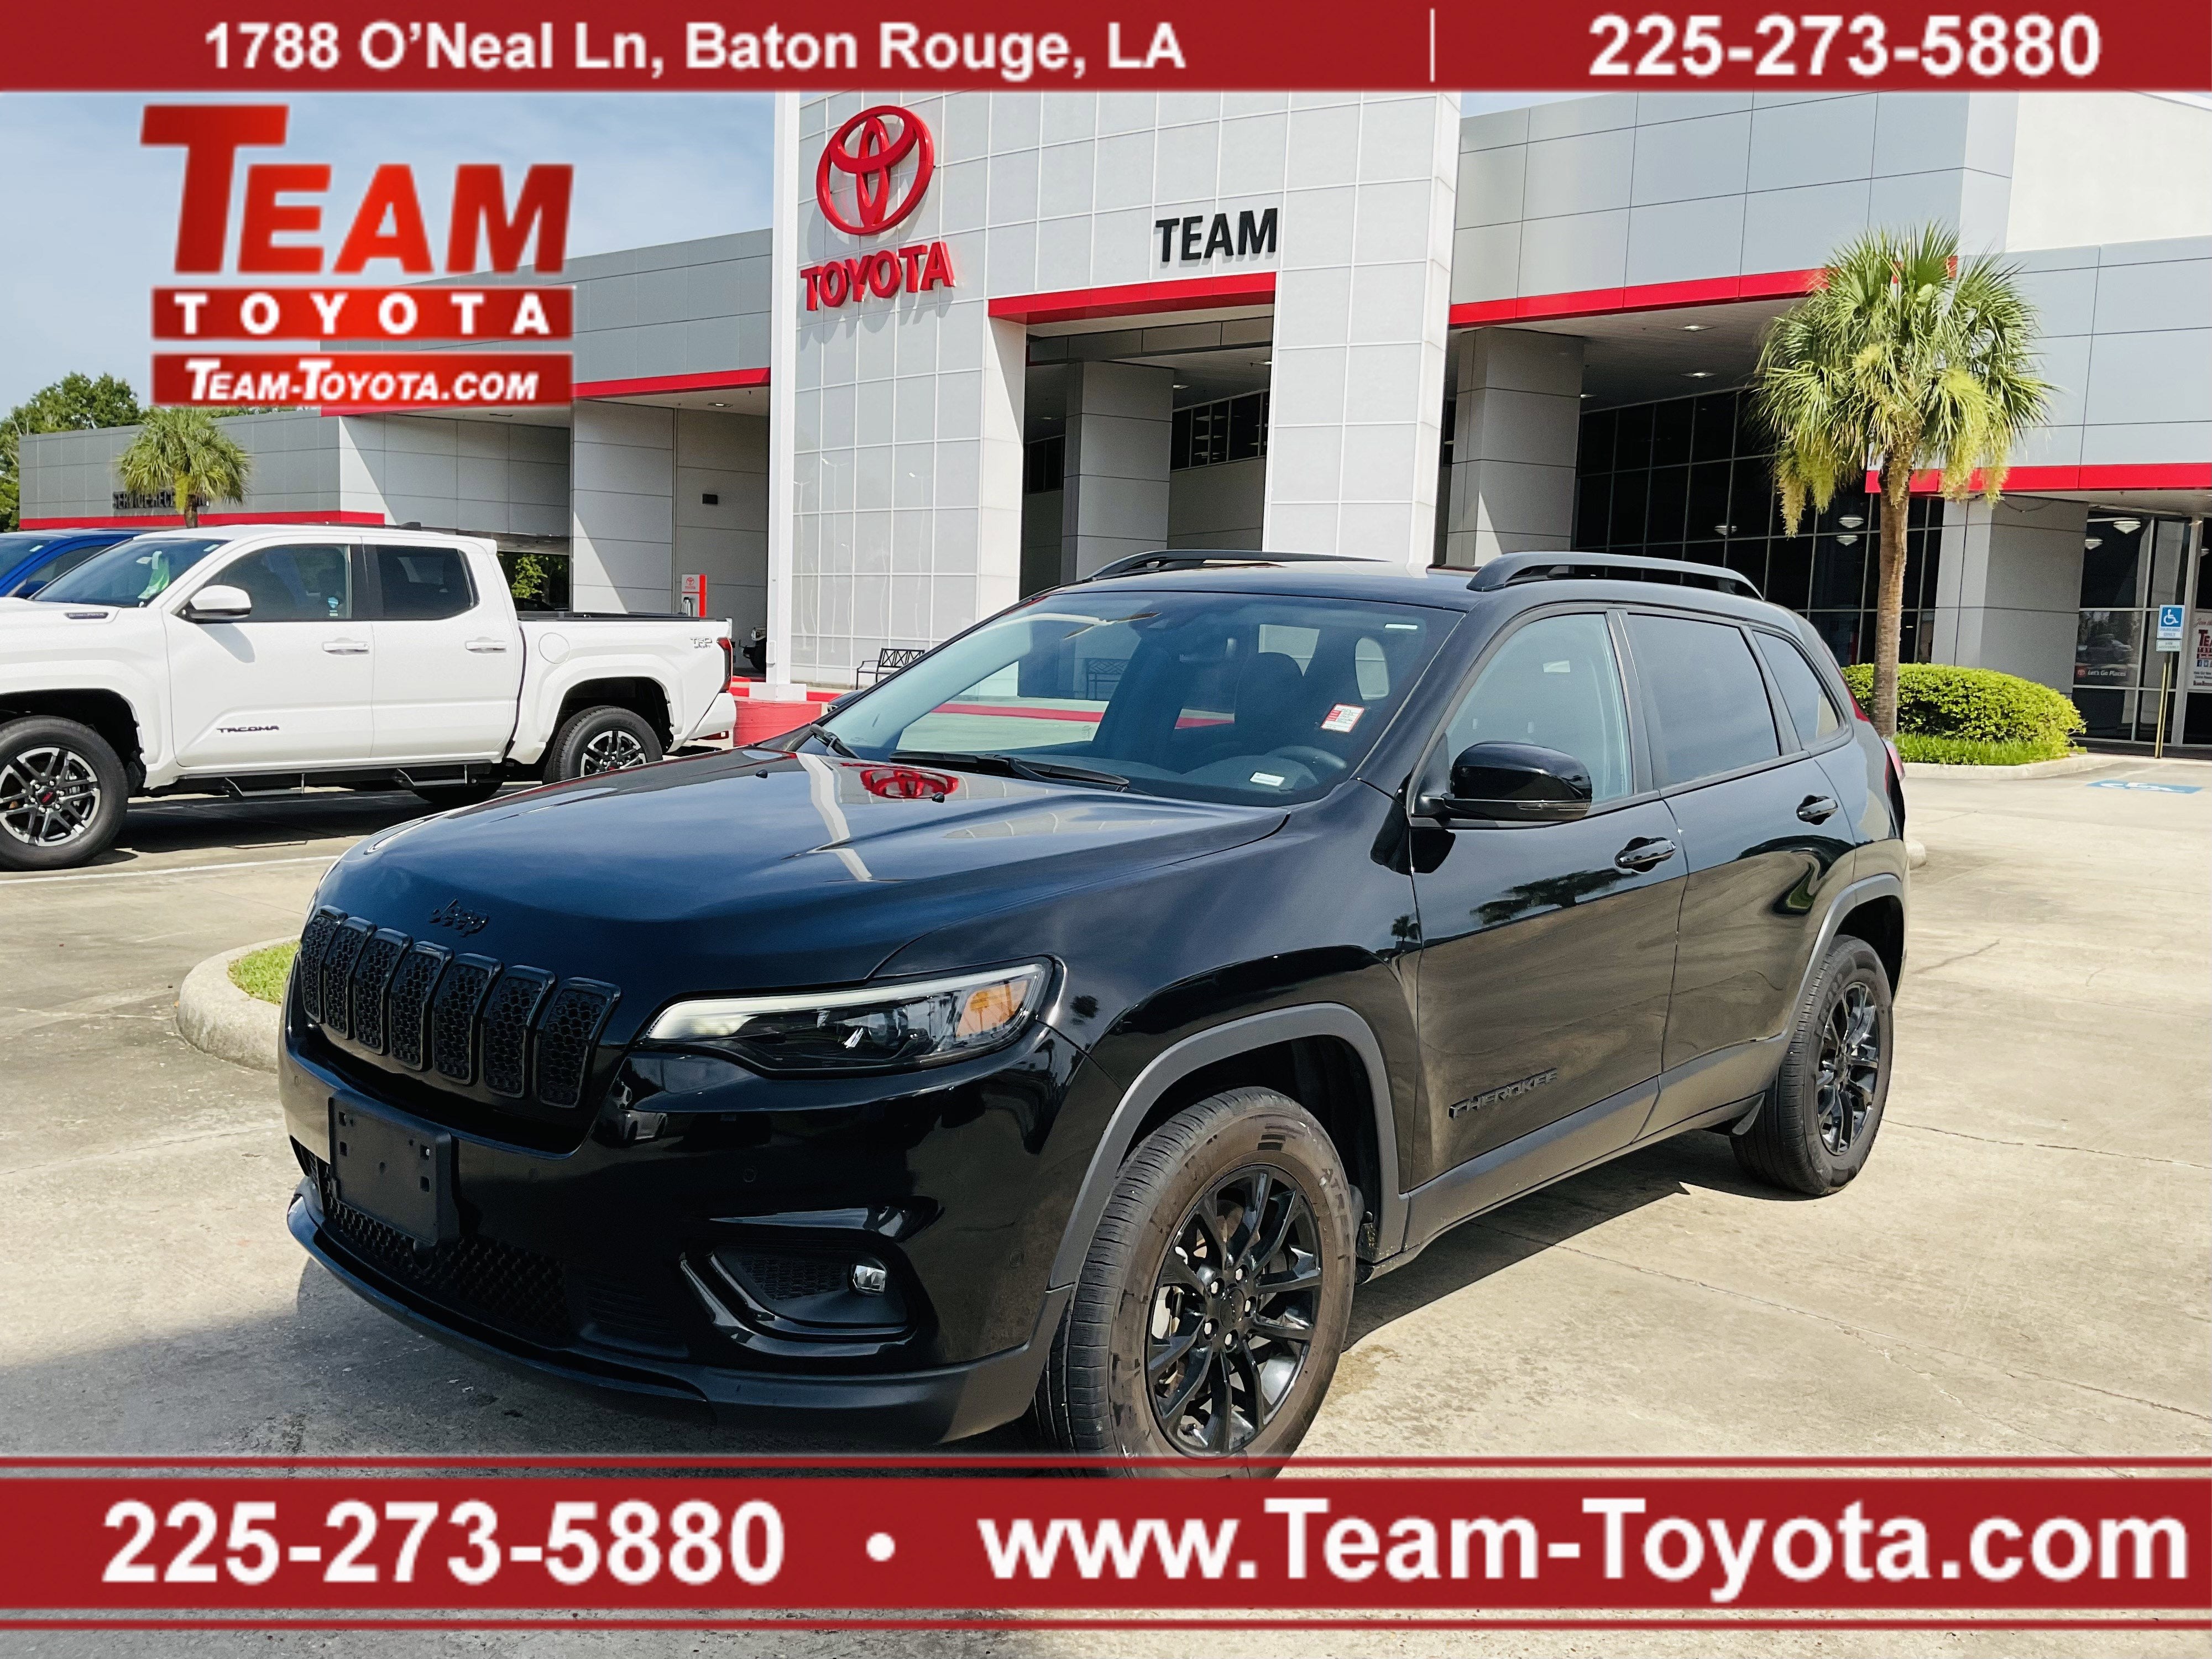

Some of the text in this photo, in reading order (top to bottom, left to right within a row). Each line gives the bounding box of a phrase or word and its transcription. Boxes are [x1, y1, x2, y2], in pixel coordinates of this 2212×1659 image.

[1155, 208, 1278, 261] TEAM
[800, 241, 955, 311] TOYOTA
[1448, 1067, 1557, 1120] CHEROKEE
